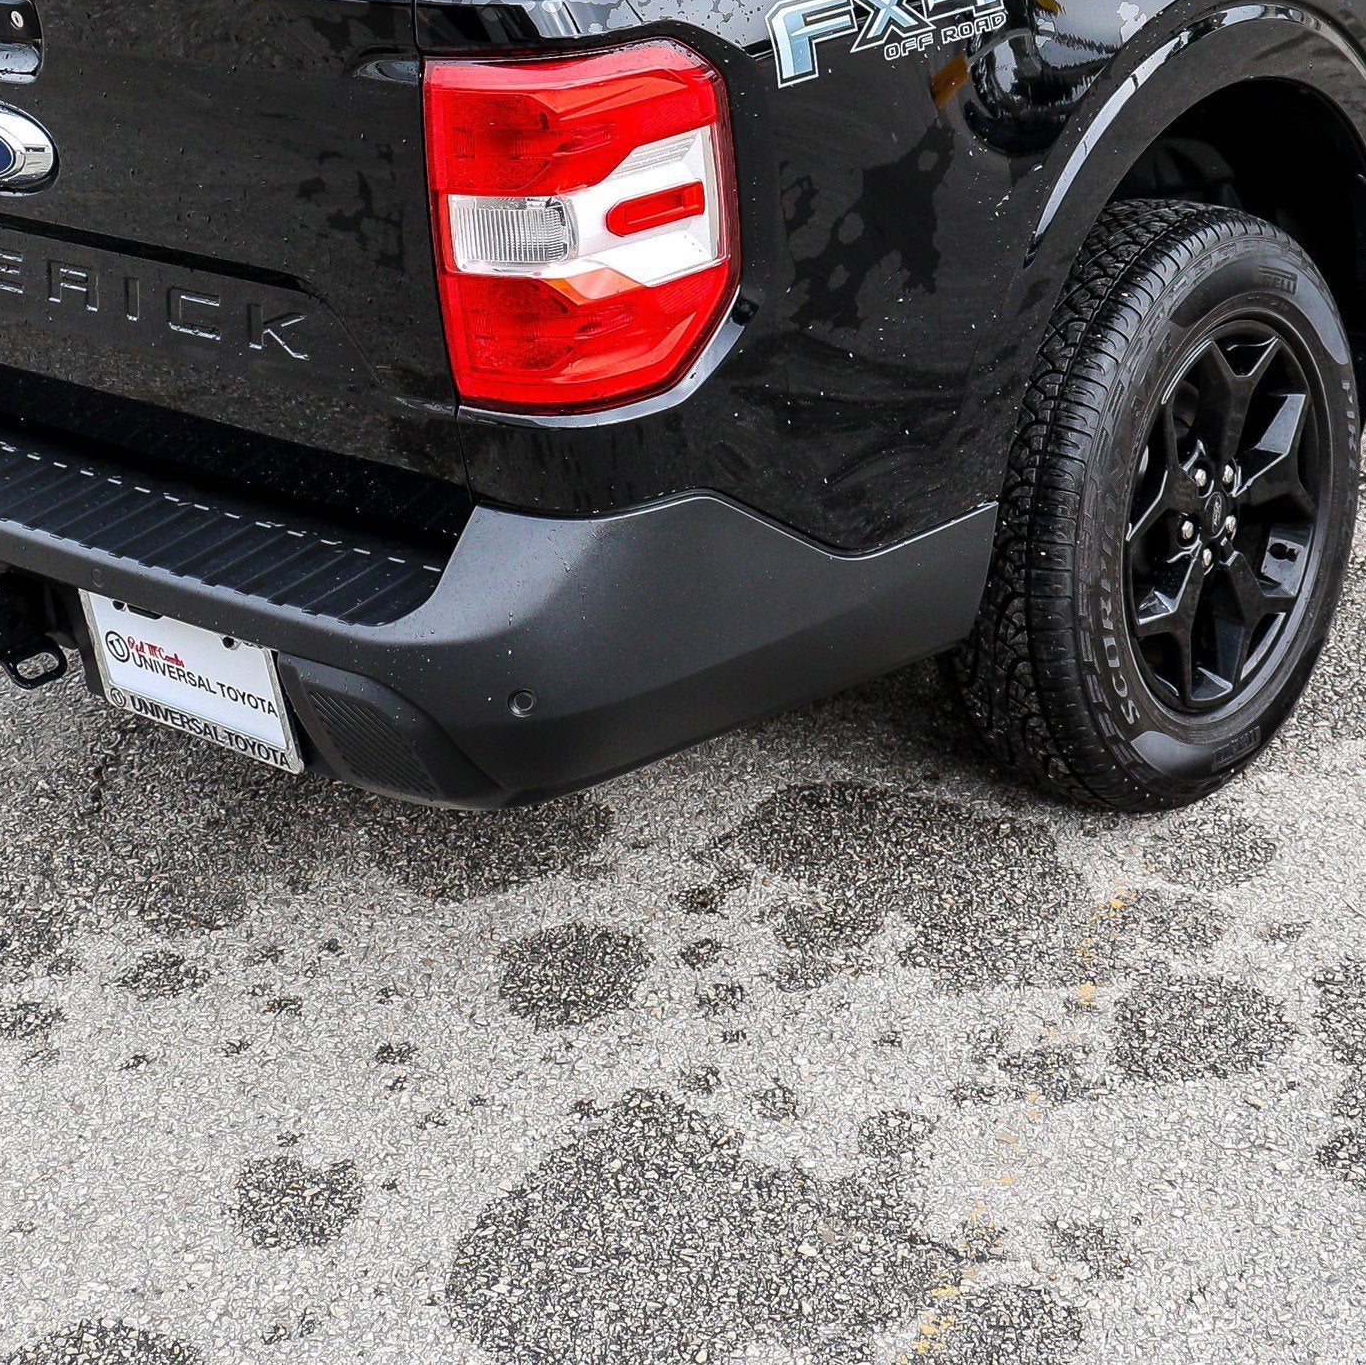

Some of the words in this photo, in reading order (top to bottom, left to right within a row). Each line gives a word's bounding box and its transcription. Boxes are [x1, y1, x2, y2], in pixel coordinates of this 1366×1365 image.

[884, 32, 934, 61] OFF
[941, 11, 1007, 45] ROAD
[132, 652, 217, 695] UNIVERSAL
[216, 681, 279, 718] TOYOTA
[130, 695, 226, 744] UNIVERSAL
[223, 729, 292, 770] TOYOTA
